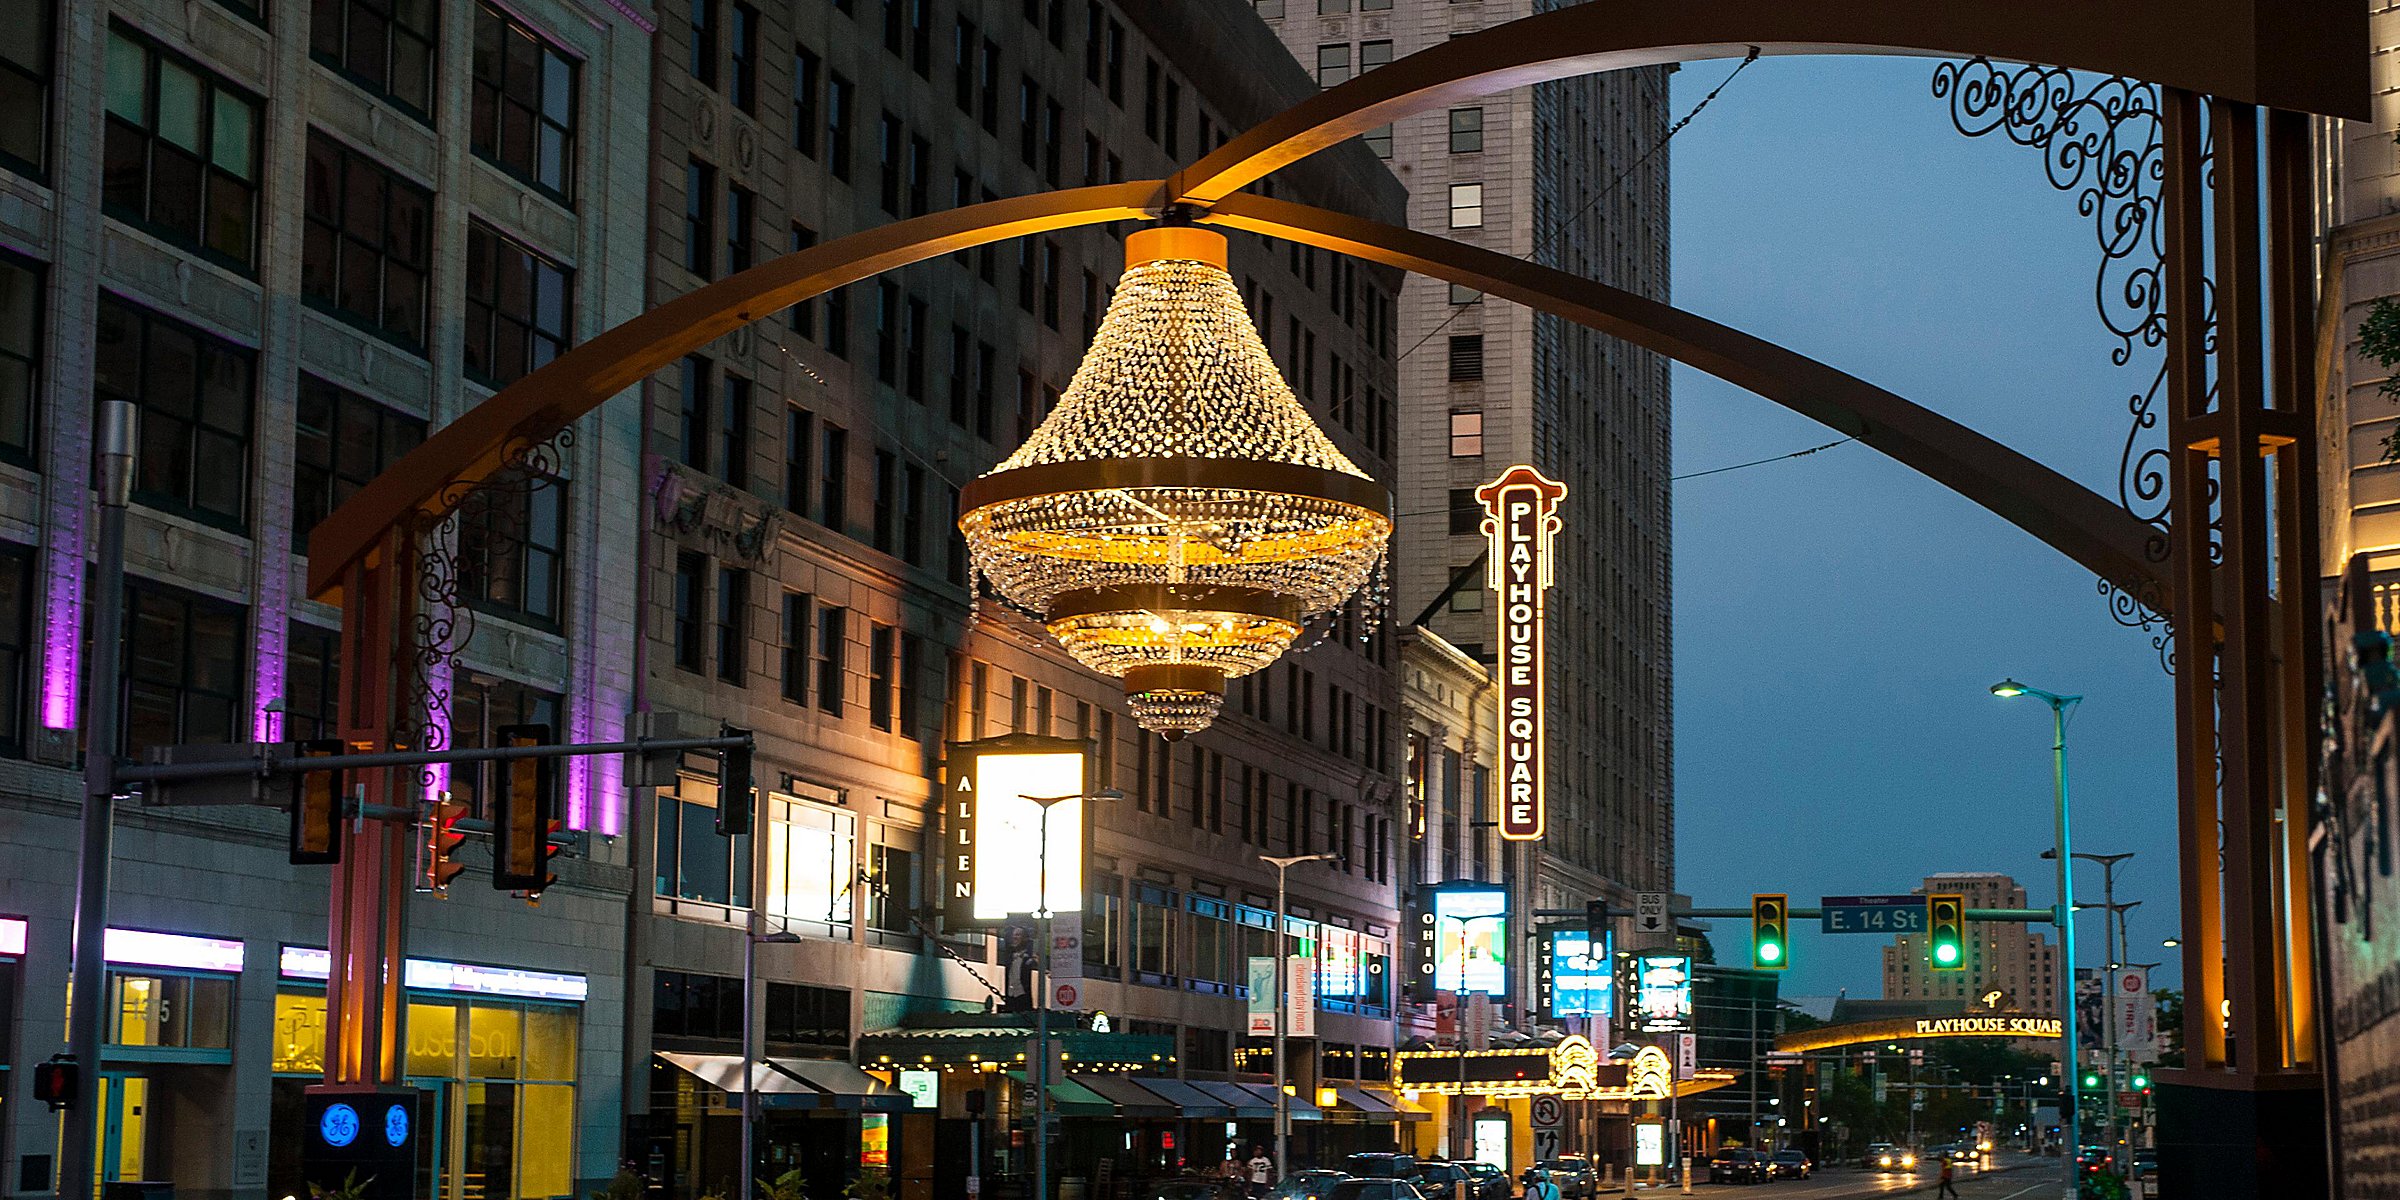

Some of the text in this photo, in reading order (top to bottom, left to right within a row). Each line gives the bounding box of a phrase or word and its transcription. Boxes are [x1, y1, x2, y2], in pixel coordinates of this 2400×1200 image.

[1509, 502, 1533, 826] PLAYHOUSE SQUARE
[955, 775, 972, 898] ALLEN
[1640, 905, 1662, 915] ONLY
[1641, 894, 1660, 905] BUS
[1831, 909, 1918, 930] E. 14 St
[1421, 913, 1435, 974] OHIO
[1541, 941, 1552, 1007] STATE
[1628, 959, 1638, 1031] PALACE
[1916, 1018, 2063, 1035] PLAYHOUSE SQUAR
